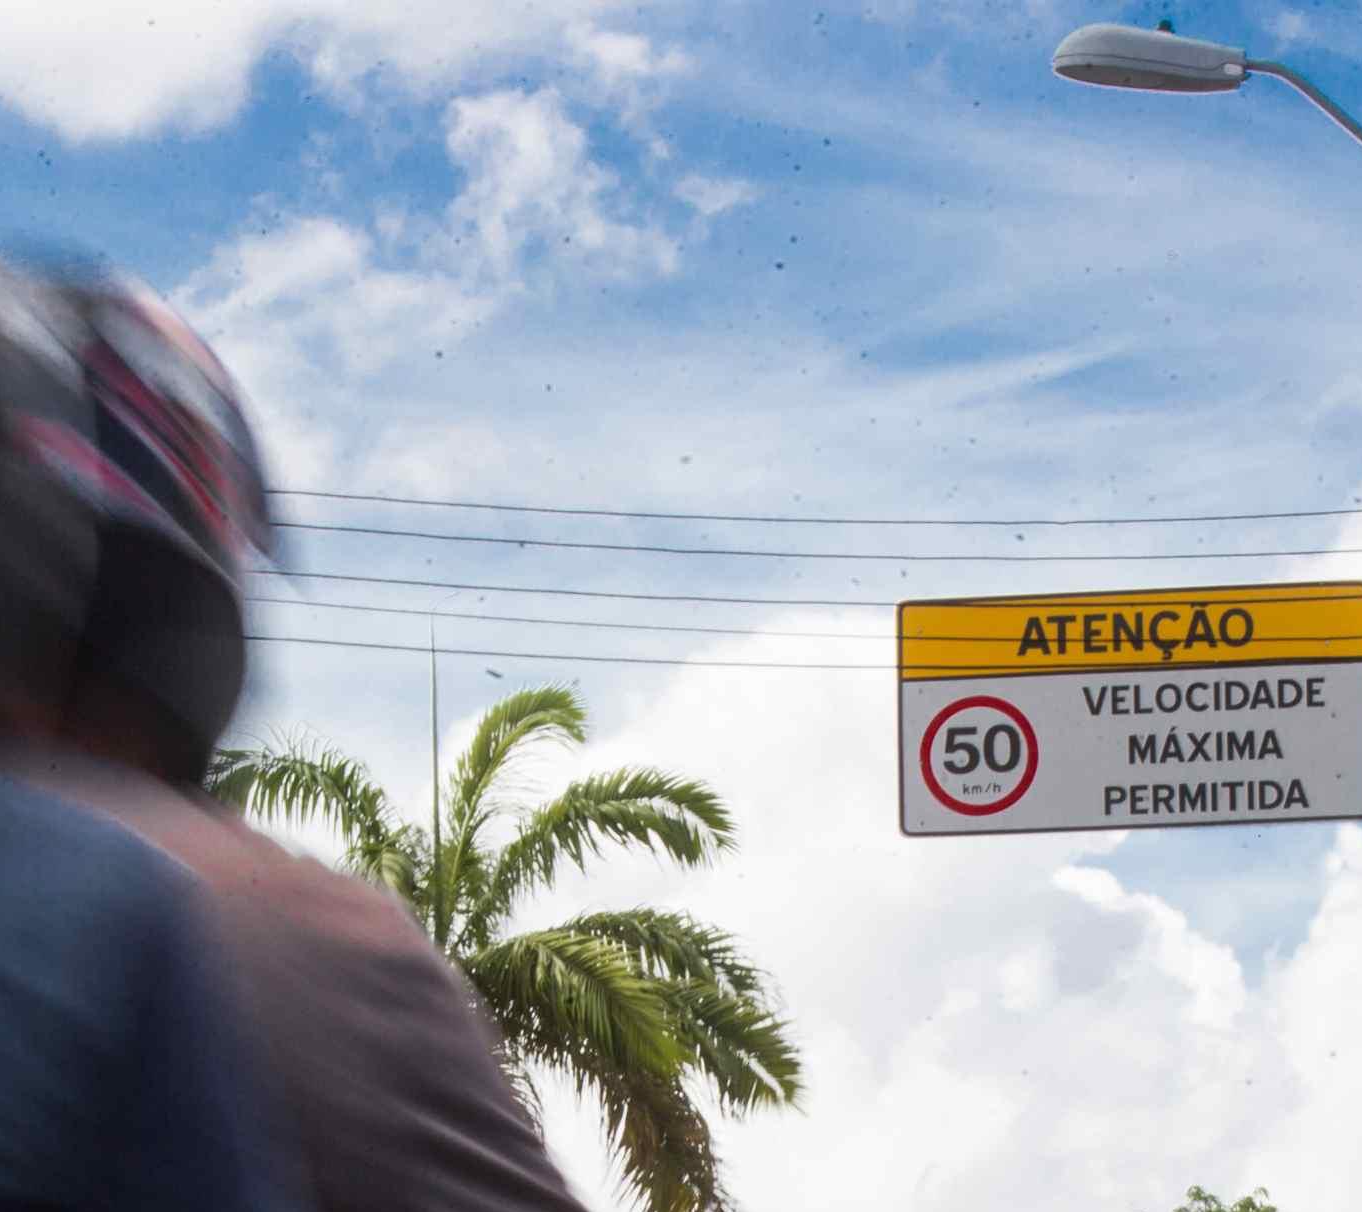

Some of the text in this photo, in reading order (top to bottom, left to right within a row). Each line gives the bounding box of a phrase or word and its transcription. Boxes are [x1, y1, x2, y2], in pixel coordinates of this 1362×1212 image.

[1017, 604, 1255, 661] ATENÇÃO
[1083, 677, 1326, 716] VELOCIDADE
[942, 724, 1021, 775] 50
[1127, 728, 1283, 765] MÁXIMA
[962, 782, 1001, 795] km/h
[1103, 779, 1310, 816] PERMITIDA
